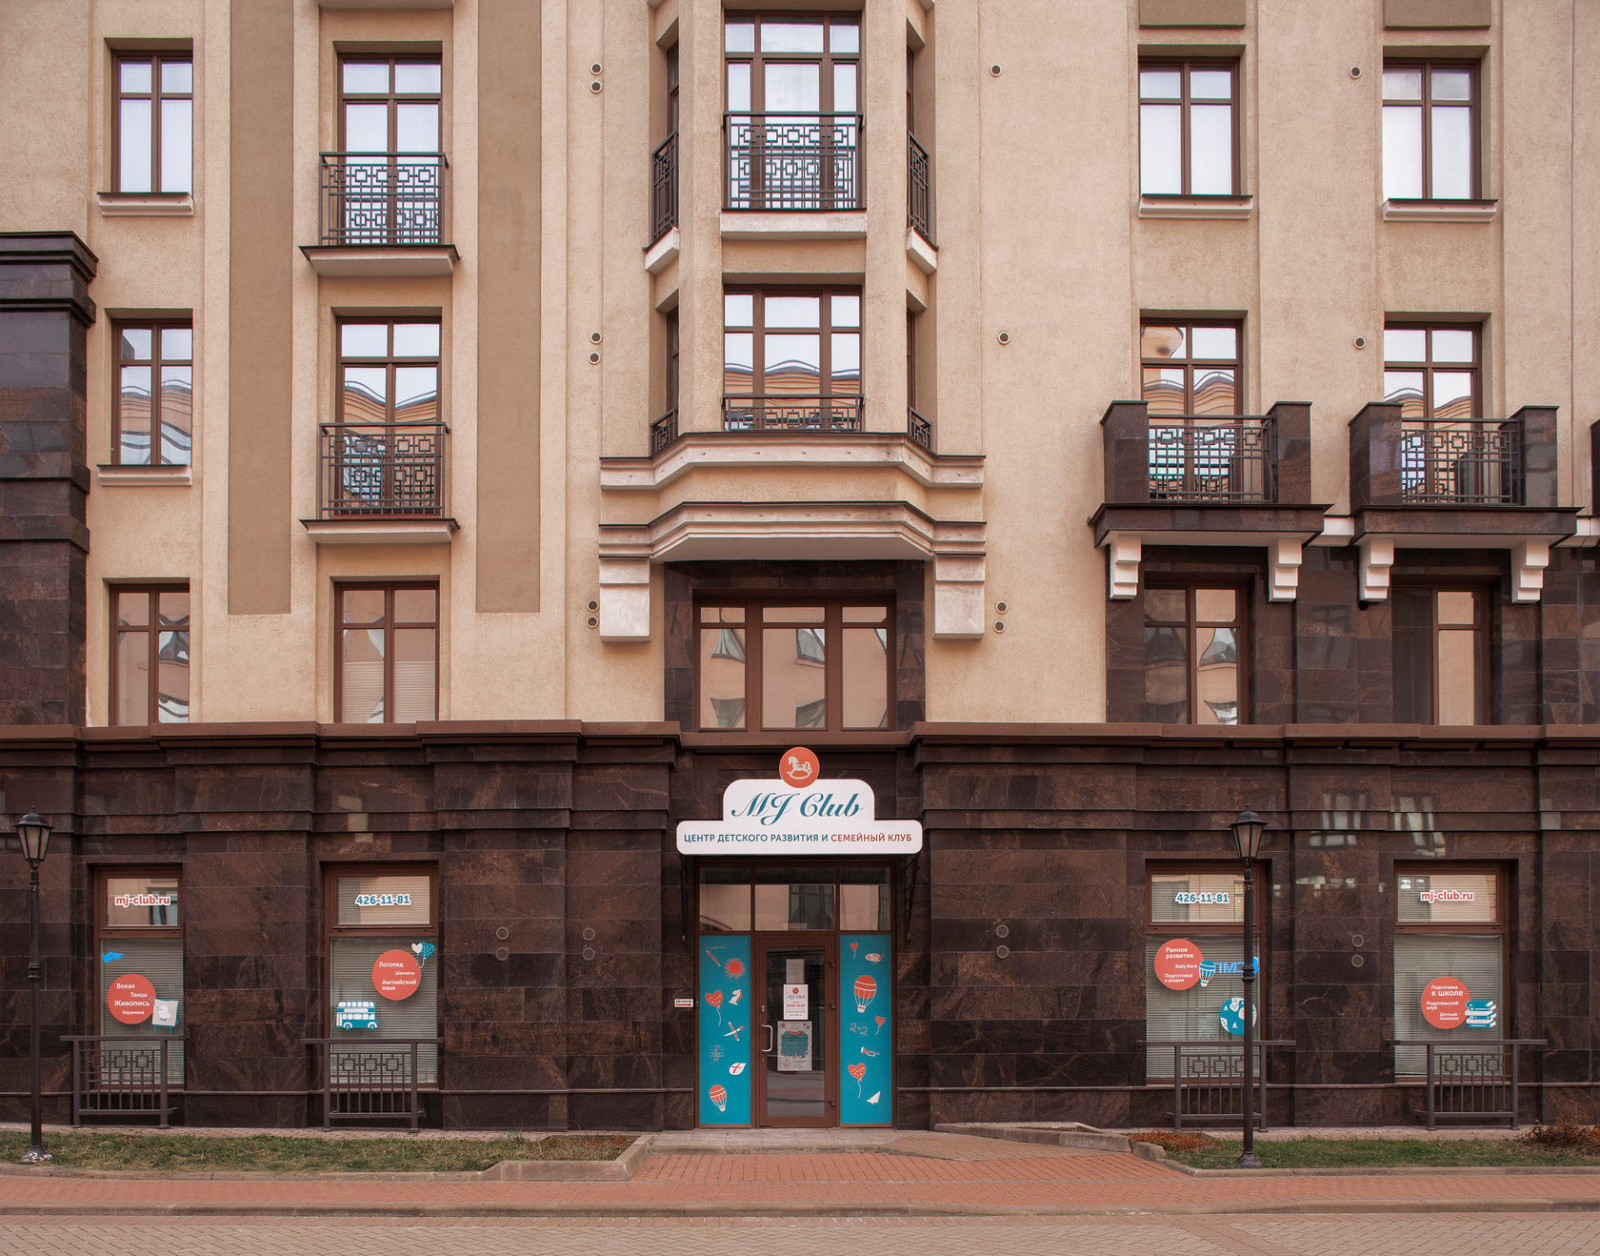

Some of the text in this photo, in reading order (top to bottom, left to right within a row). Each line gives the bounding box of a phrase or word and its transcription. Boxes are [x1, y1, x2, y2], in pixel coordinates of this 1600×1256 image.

[731, 792, 864, 826] MJ Club
[683, 832, 912, 844] ЦЕНТР ДЕТСКОГО РАЗВИТИЯ И СЕМЕЙНЫЙ КЛУБ
[115, 894, 171, 907] mj-club.ru
[355, 894, 411, 906] 426-11-81
[1175, 892, 1230, 904] 426-11-81
[1420, 890, 1474, 903] mj-club.ru
[381, 978, 417, 986] Английский
[114, 999, 150, 1007] Живопись
